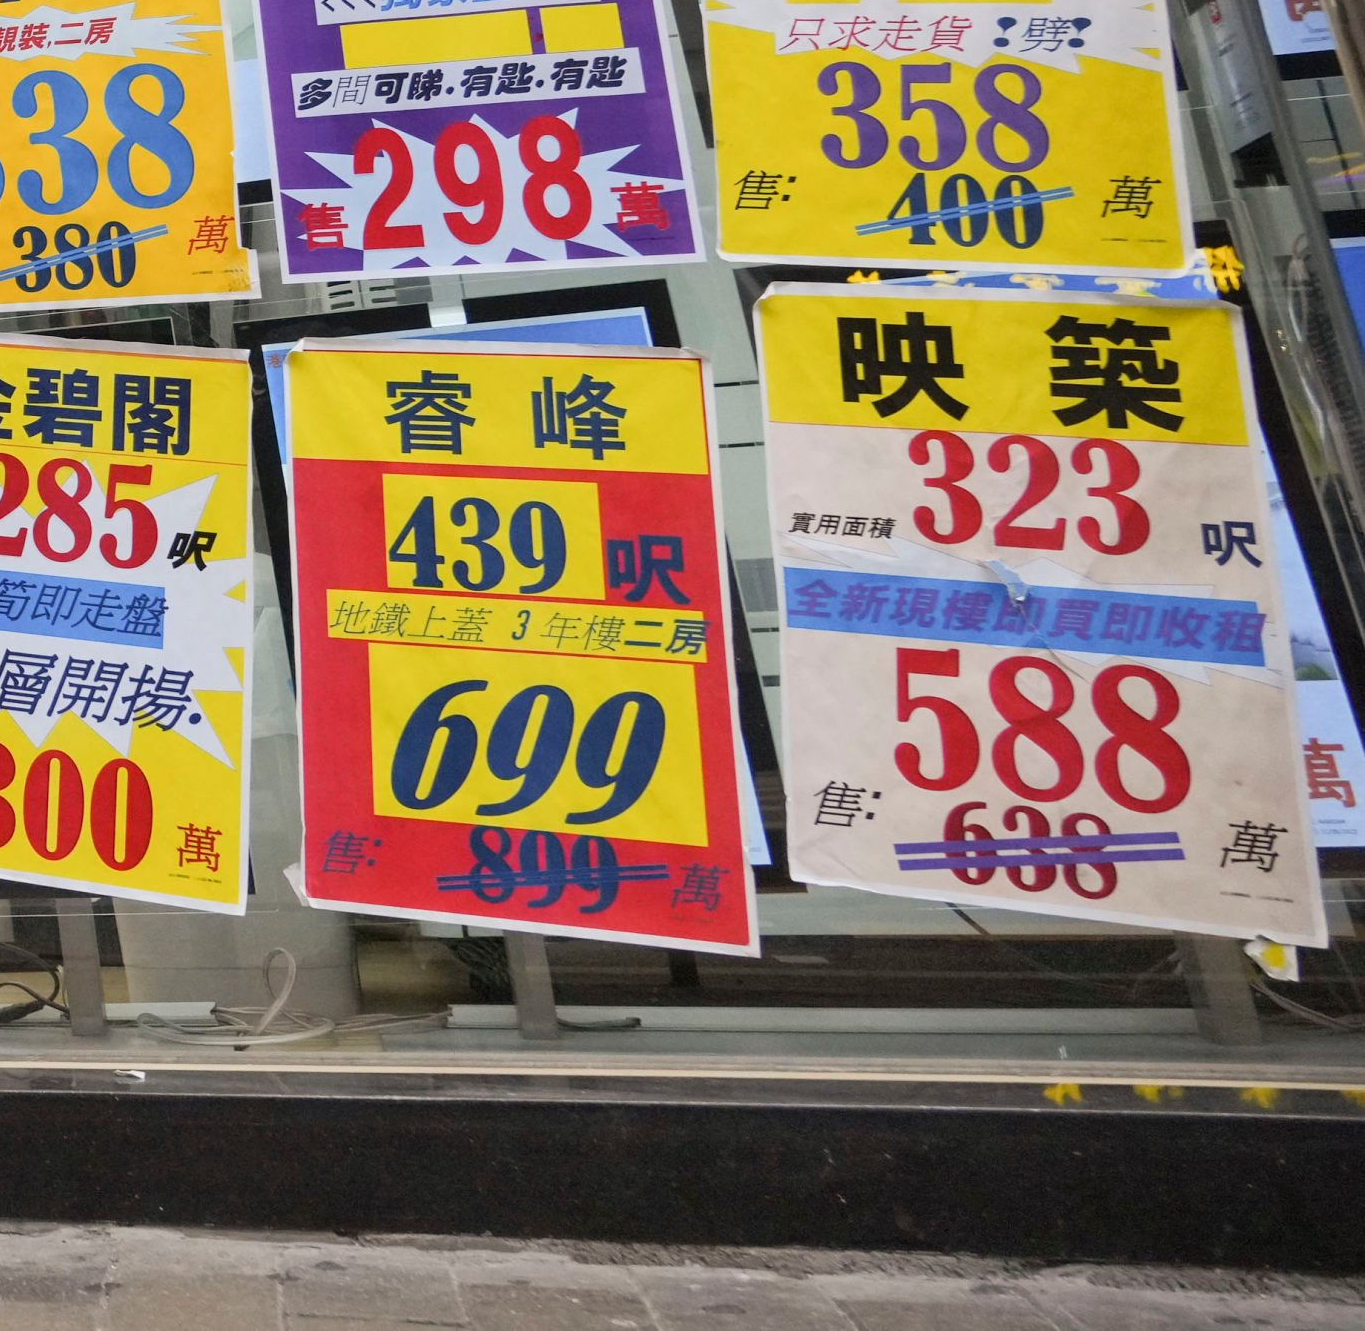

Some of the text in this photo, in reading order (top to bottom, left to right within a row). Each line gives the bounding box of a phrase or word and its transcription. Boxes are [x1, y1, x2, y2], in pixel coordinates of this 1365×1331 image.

[815, 61, 1051, 173] 358
[351, 113, 595, 252] 298
[388, 494, 568, 592] 439
[906, 429, 1152, 557] 323
[790, 580, 1266, 654] 全新現樓即買即收租
[390, 680, 668, 825] 699
[893, 646, 1193, 815] 588
